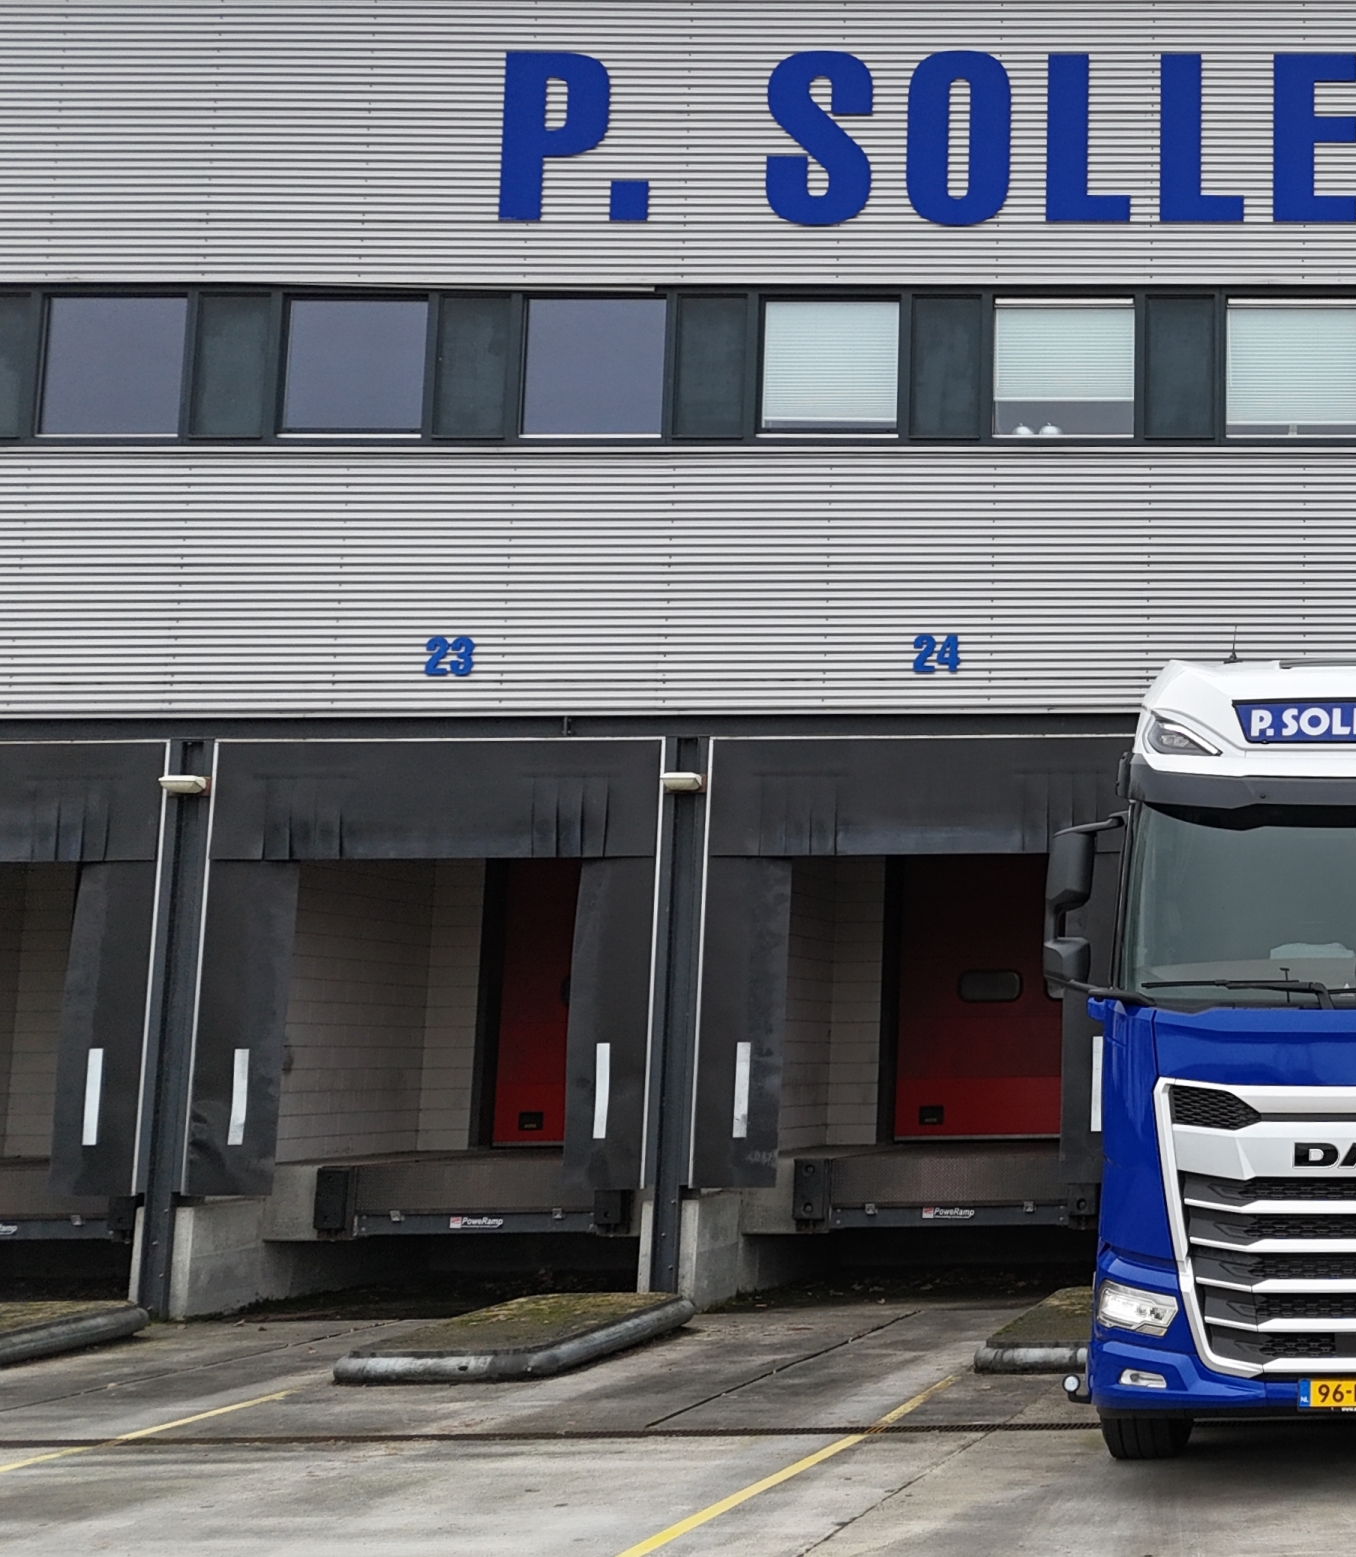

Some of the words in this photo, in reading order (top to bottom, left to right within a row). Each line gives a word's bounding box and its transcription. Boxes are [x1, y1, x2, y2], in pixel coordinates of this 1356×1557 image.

[498, 50, 650, 222] P.
[425, 636, 475, 676] 23
[913, 634, 960, 672] 24
[1250, 709, 1275, 737] P.
